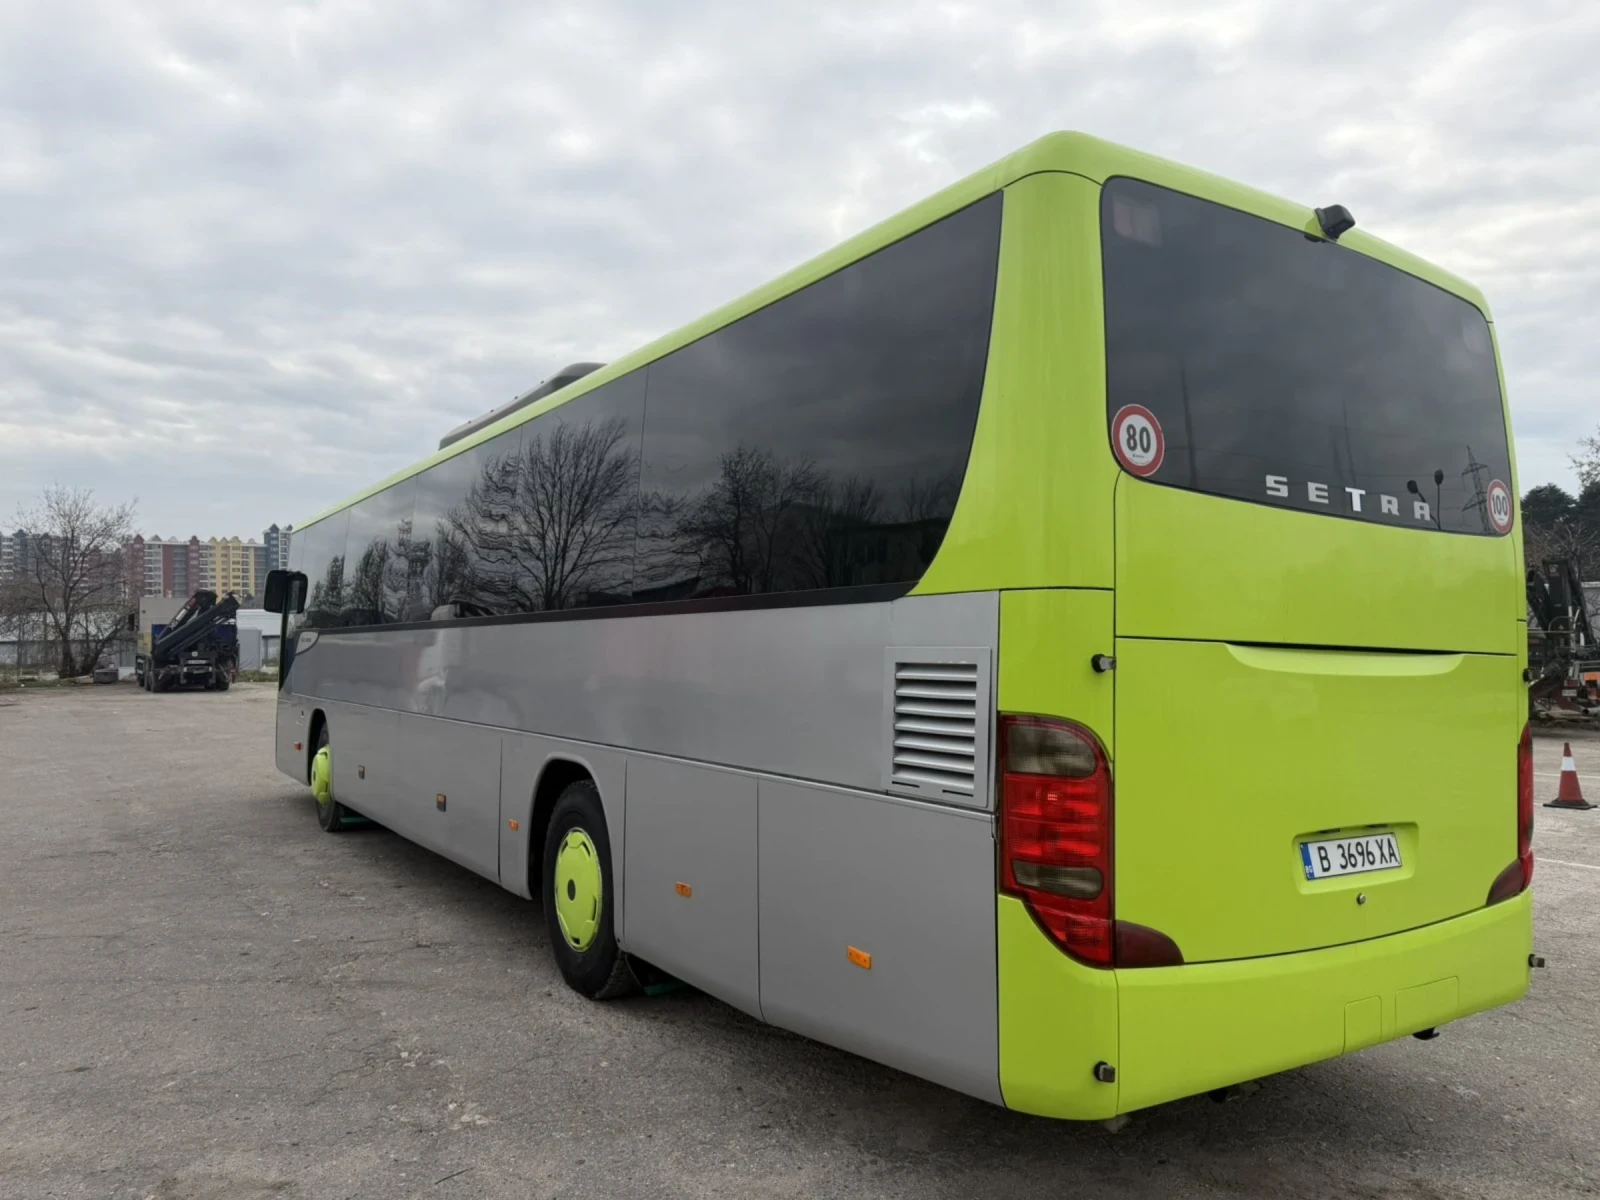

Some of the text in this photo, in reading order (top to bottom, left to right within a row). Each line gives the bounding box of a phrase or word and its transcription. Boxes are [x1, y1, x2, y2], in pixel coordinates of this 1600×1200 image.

[1126, 423, 1151, 453] 80
[1265, 474, 1431, 521] SETRA
[1492, 494, 1508, 516] 100
[1317, 846, 1331, 872] B
